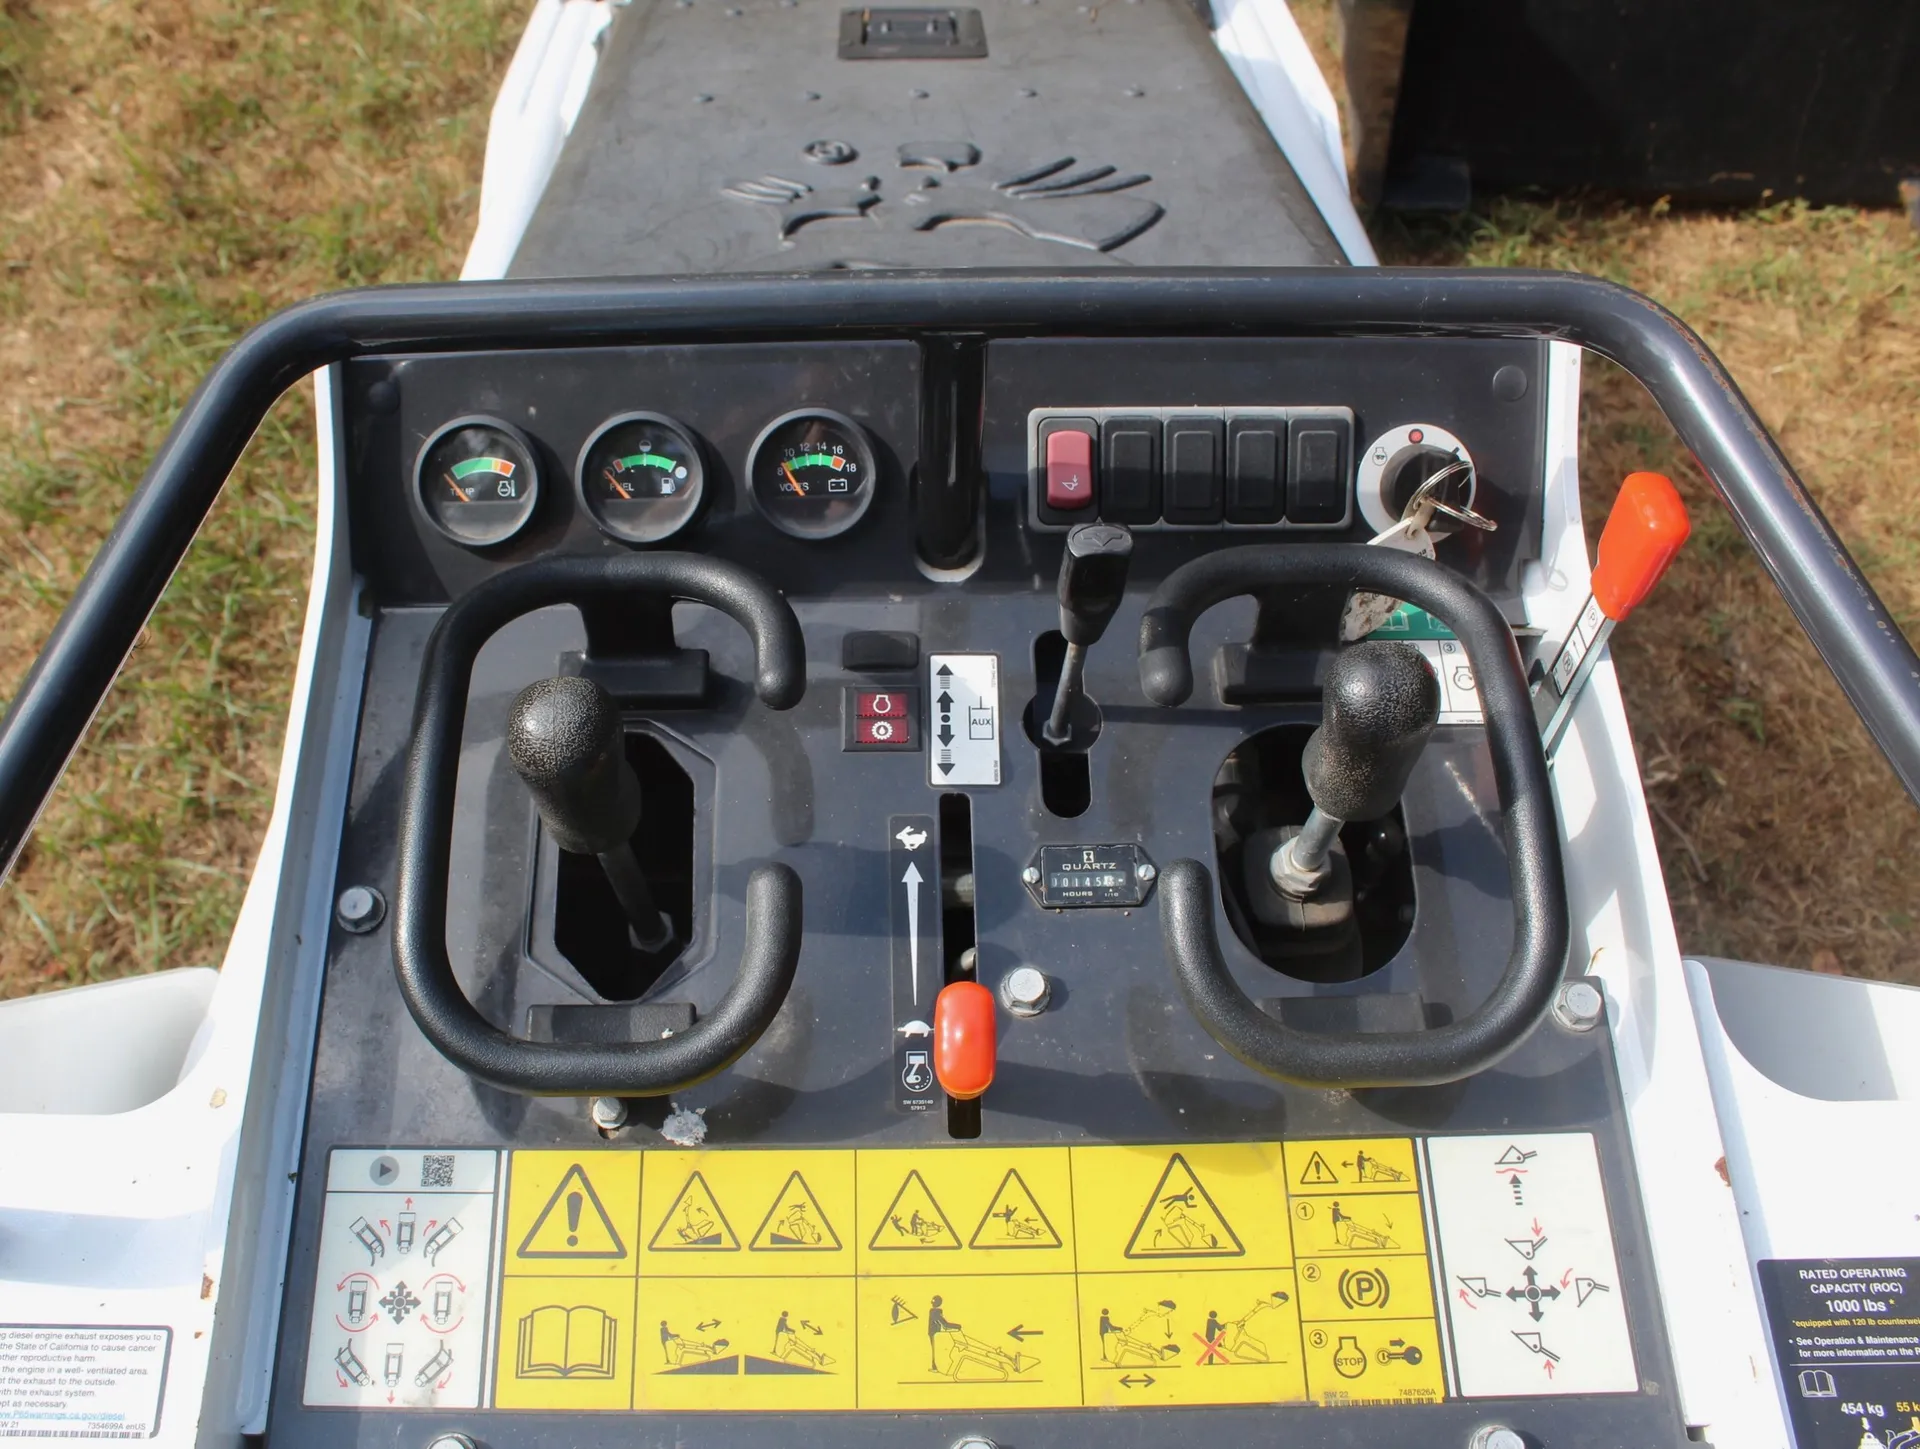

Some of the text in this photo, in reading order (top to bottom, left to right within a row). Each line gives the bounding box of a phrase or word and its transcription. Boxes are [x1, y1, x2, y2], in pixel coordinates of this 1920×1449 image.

[800, 443, 810, 451] 12
[816, 442, 827, 450] 14
[832, 445, 844, 454] 16
[784, 448, 795, 457] 10
[777, 467, 784, 476] 8
[846, 463, 857, 472] 18
[450, 487, 475, 496] TMP
[1446, 644, 1453, 652] 3
[1062, 862, 1116, 871] QUARTZ
[1300, 1204, 1309, 1218] 1
[1799, 1267, 1907, 1280] RATED OPERATING
[1306, 1266, 1374, 1300] 2 P
[1810, 1282, 1903, 1295] CAPACITY (ROC)
[1826, 1299, 1886, 1313] 1000 lbs
[1852, 1318, 1866, 1326] 120
[1867, 1318, 1876, 1326] lb
[35, 1333, 62, 1341] engine
[99, 1334, 133, 1342] exposes
[1796, 1336, 1919, 1347] See Operation & Maintenance
[50, 1343, 89, 1351] California
[1313, 1332, 1365, 1367] 3 STOP
[1799, 1349, 1811, 1357] for
[1813, 1349, 1835, 1357] more
[1836, 1348, 1885, 1357] information
[1899, 1347, 1913, 1356] the
[21, 1355, 72, 1363] reproductive
[19, 1367, 45, 1375] engine
[1324, 1391, 1339, 1399] SW
[1399, 1388, 1436, 1396] 7487626A
[1840, 1402, 1885, 1417] 454 kg
[1896, 1402, 1911, 1412] 55
